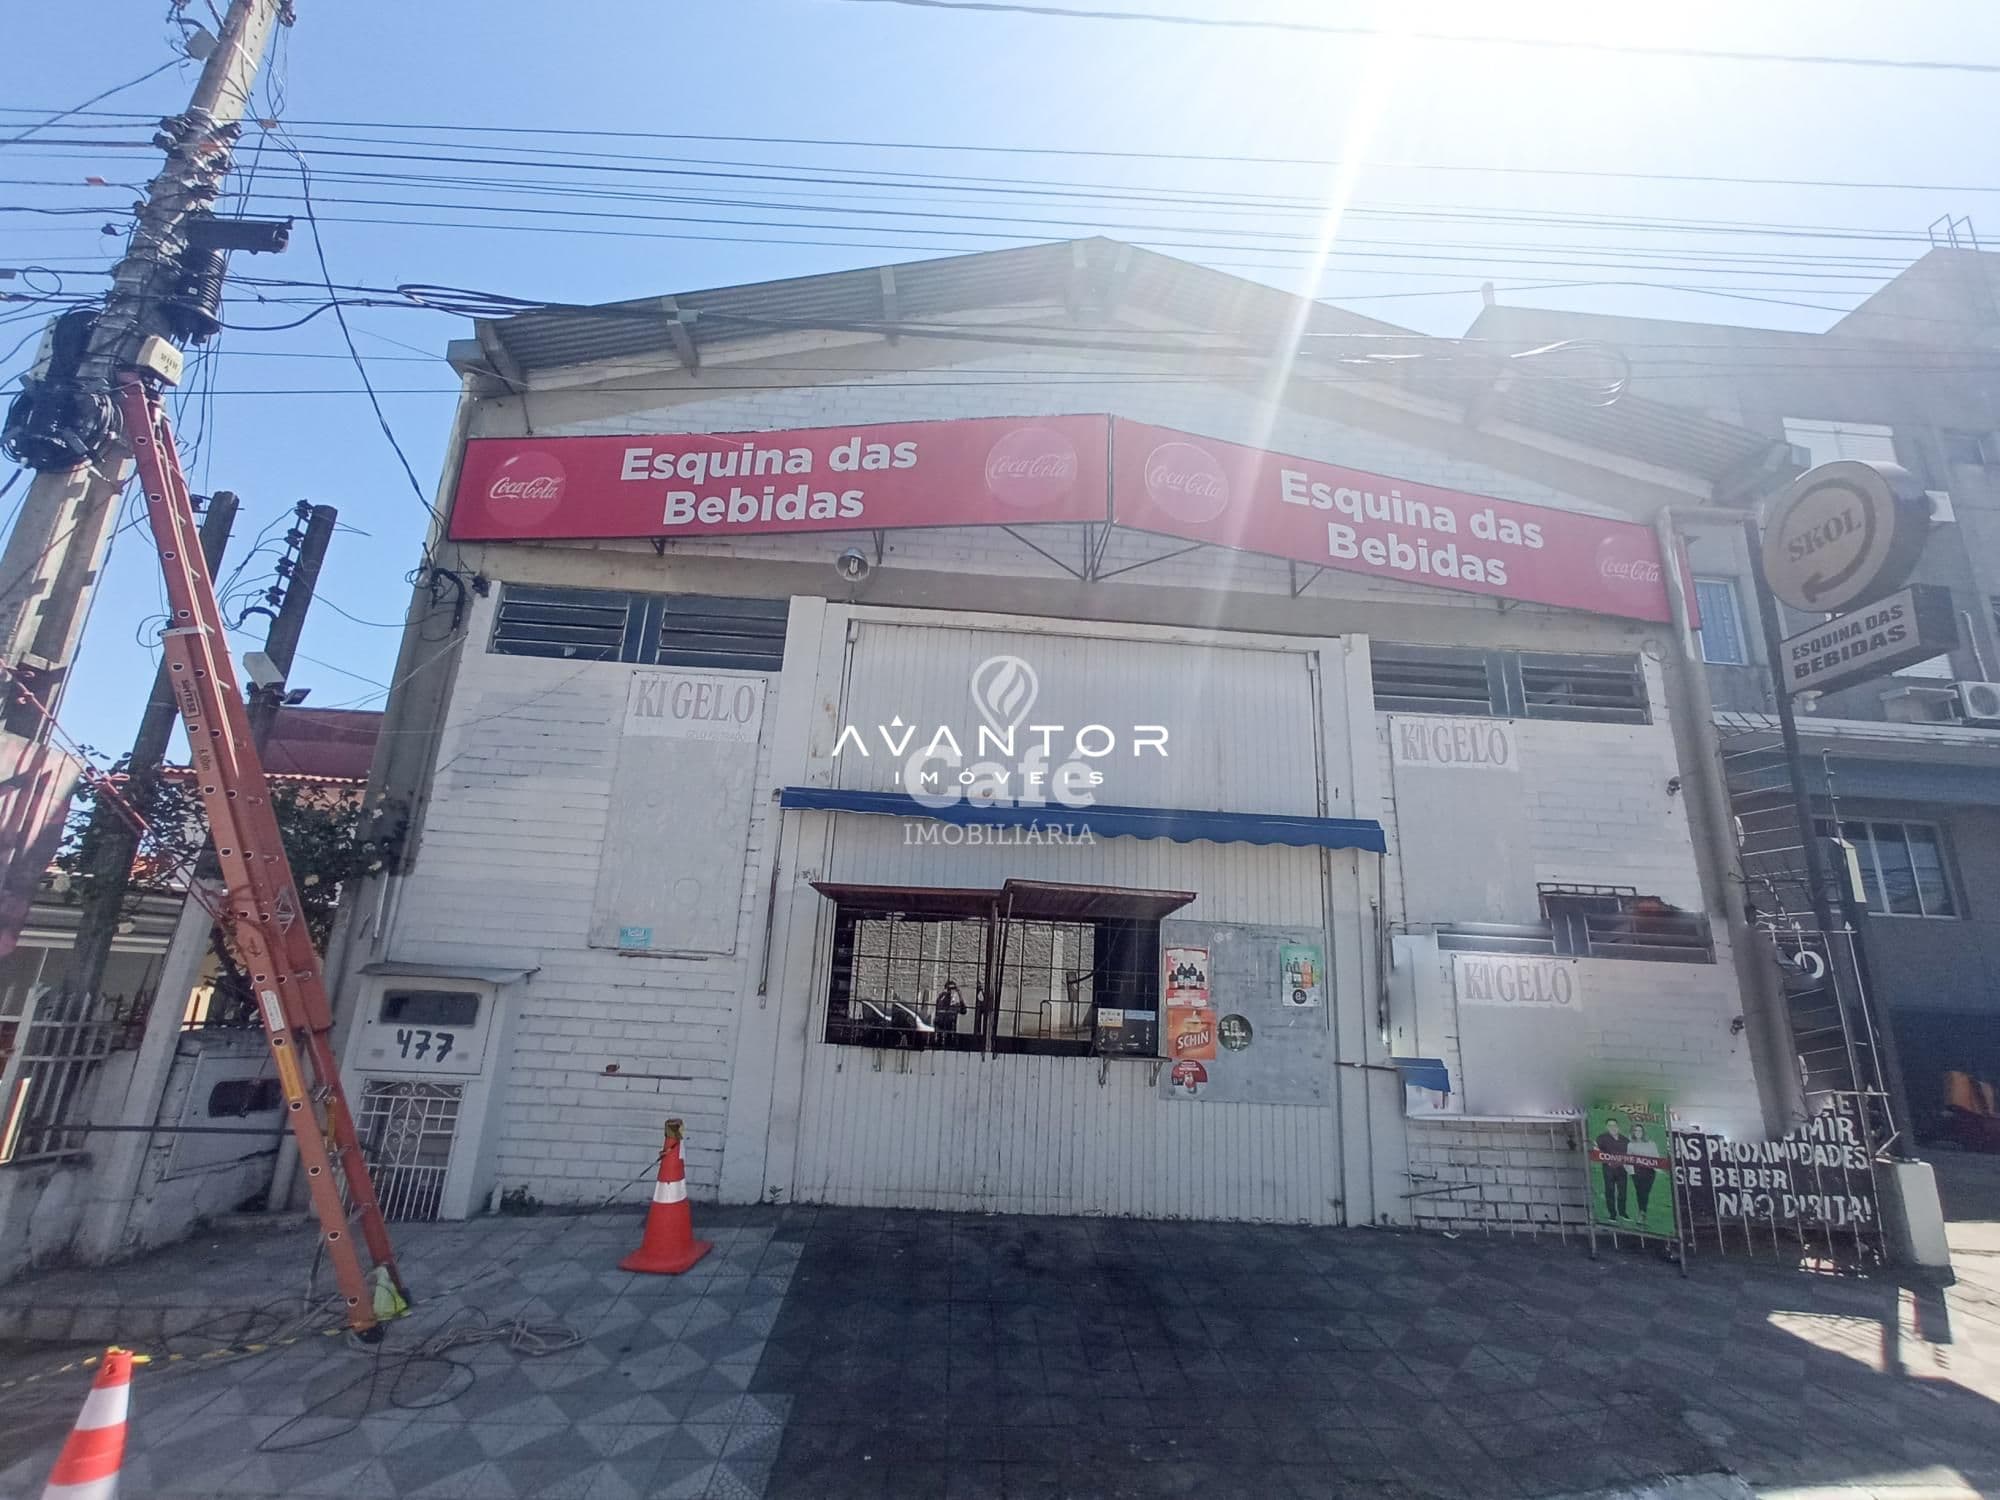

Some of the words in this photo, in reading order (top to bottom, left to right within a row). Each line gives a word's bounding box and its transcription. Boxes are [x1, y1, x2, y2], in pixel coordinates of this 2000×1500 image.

[620, 442, 811, 488] Esquina
[828, 436, 918, 475] das
[489, 476, 562, 499] Coca-Cola
[662, 484, 866, 526] Bebidas
[1280, 468, 1457, 534] Esquina
[1469, 506, 1545, 549] das
[1327, 521, 1508, 586] Bebidas
[1787, 508, 1862, 563] SKOL
[1792, 621, 1862, 661] ESQUINA
[1865, 603, 1905, 631] DAS
[1793, 623, 1907, 680] BEBIDAS
[396, 1028, 455, 1063] 477
[1177, 1031, 1209, 1050] SCHIN
[1599, 1152, 1634, 1162] COMPRE
[1635, 1158, 1659, 1167] AQUI
[1706, 1137, 1869, 1170] PROXIMIDADES
[1674, 1165, 1703, 1187] SE
[1710, 1166, 1788, 1190] BEBER
[1718, 1188, 1775, 1221] NÃO
